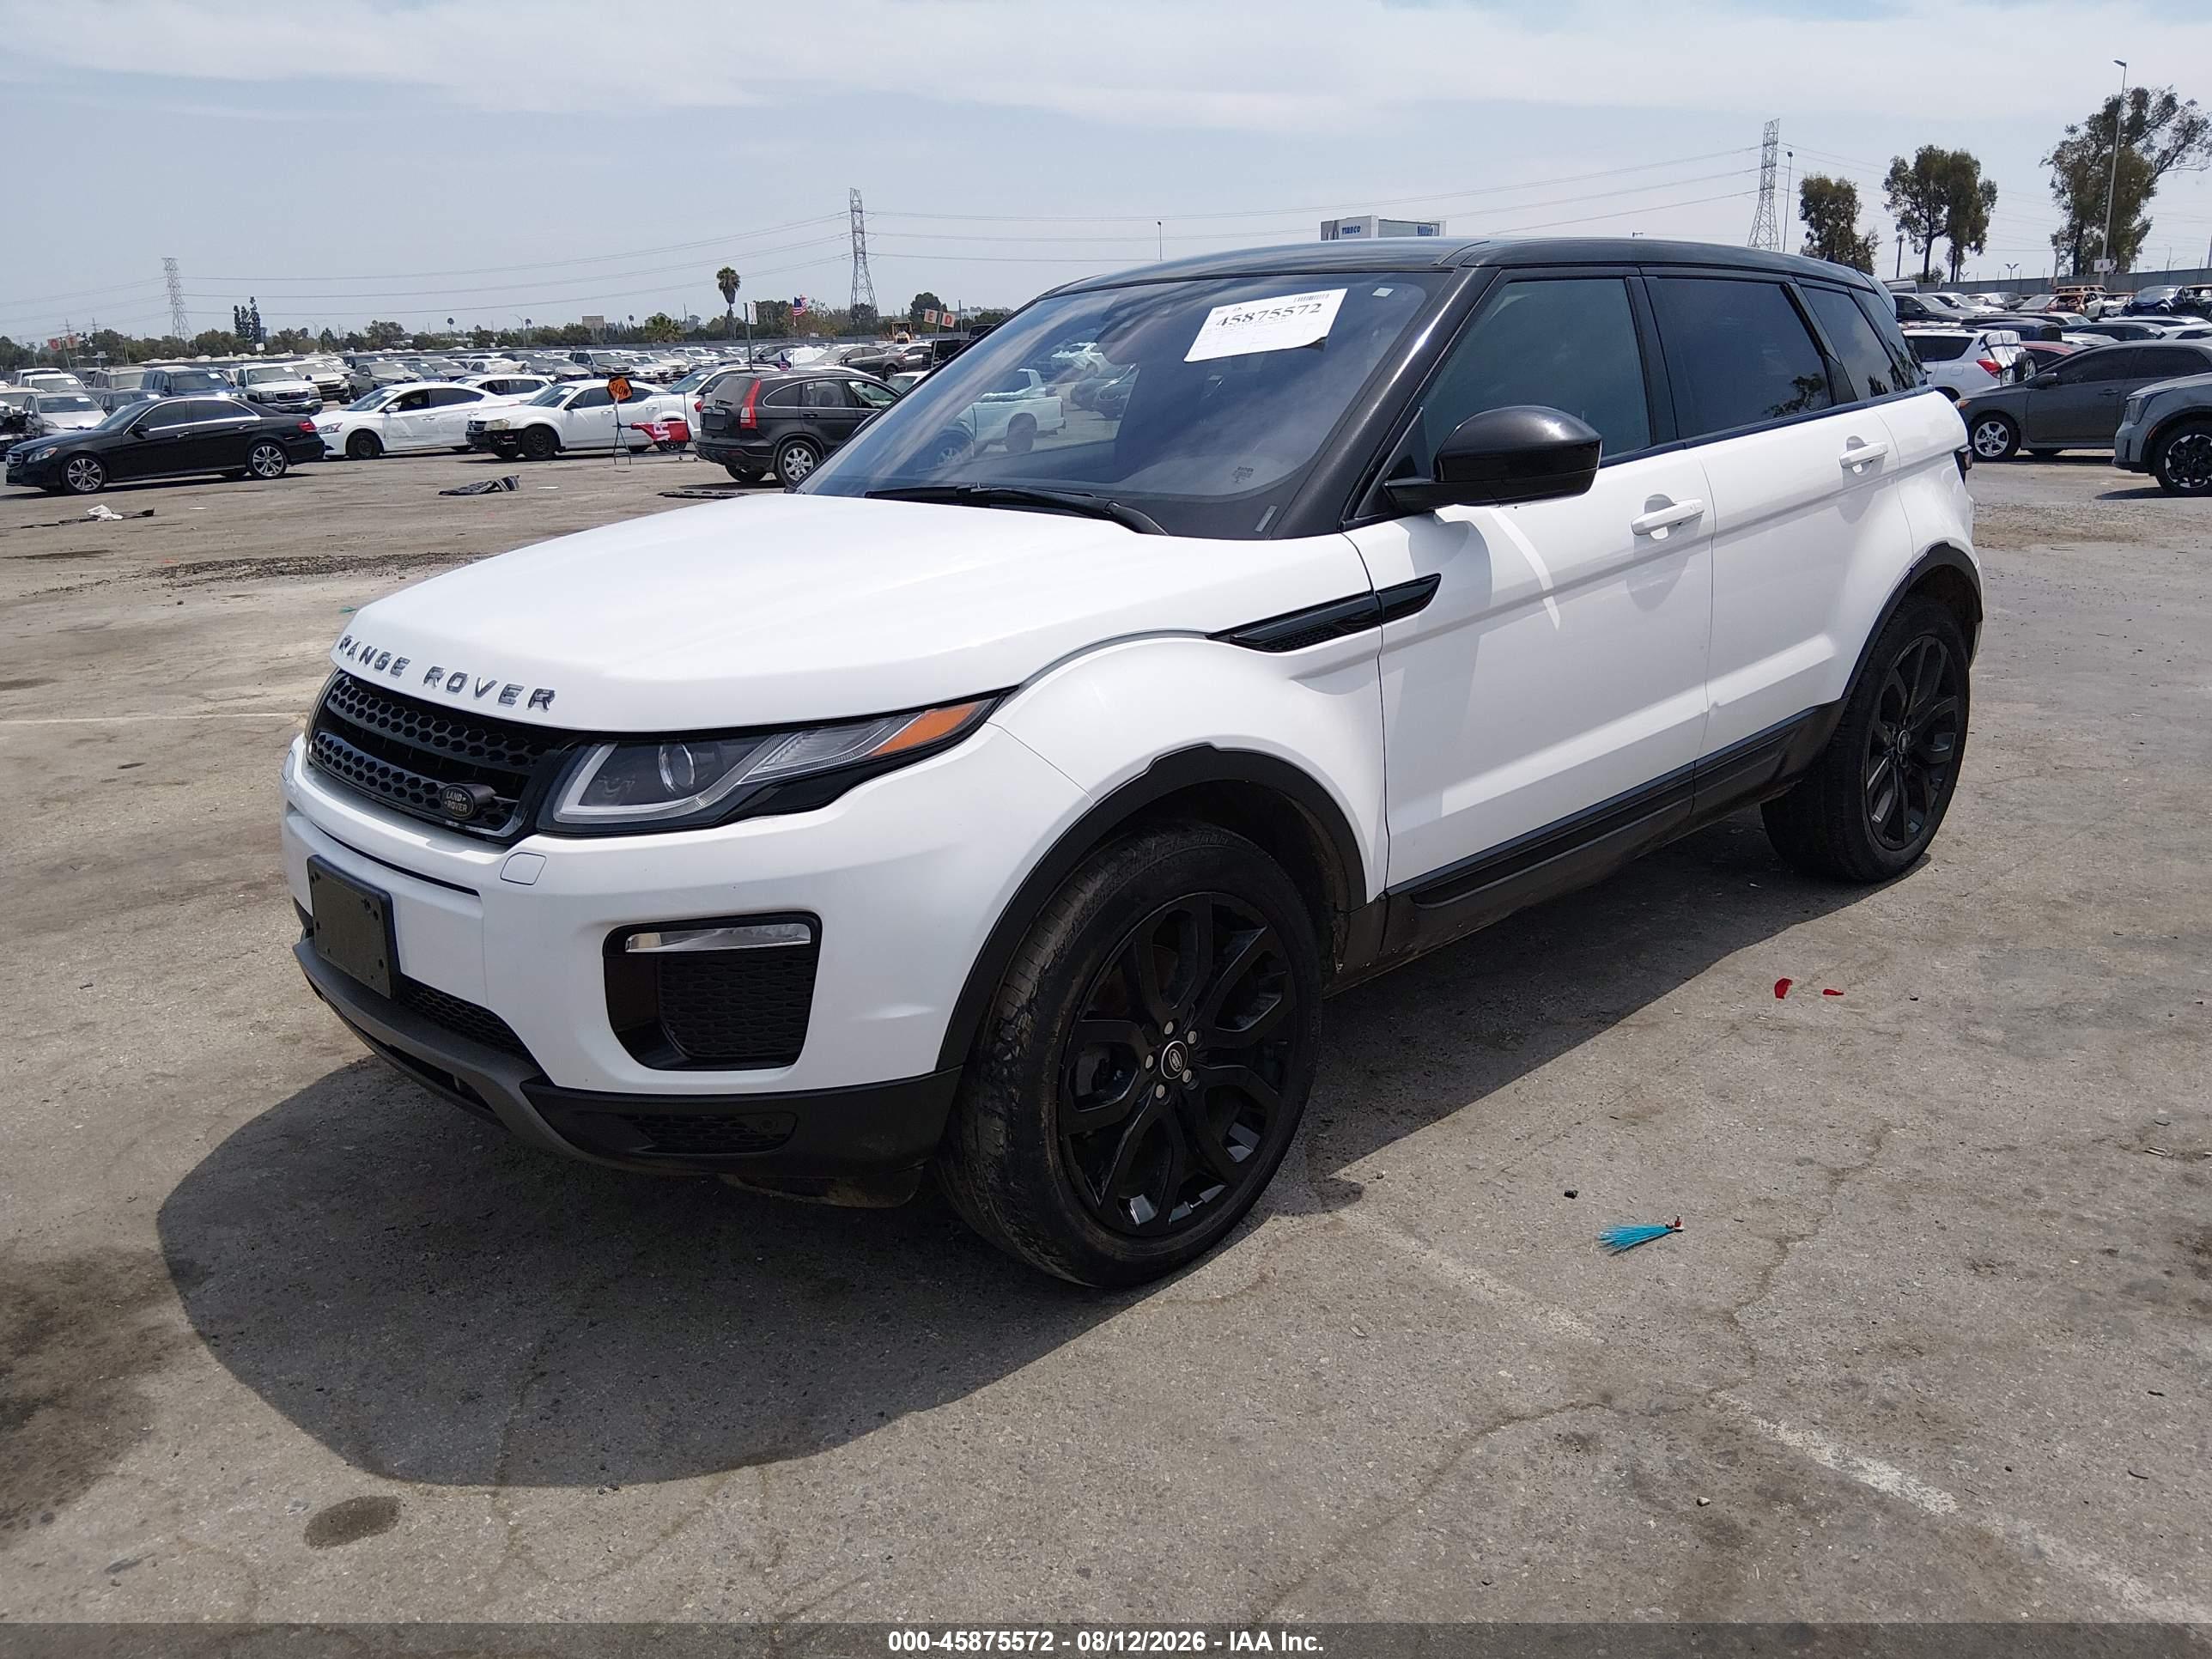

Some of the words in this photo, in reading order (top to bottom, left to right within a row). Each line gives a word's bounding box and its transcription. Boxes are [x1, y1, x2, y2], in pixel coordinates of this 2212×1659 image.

[928, 311, 934, 322] E
[945, 314, 952, 325] D
[1216, 302, 1322, 326] 45875572
[611, 382, 629, 397] SLOW
[337, 634, 410, 678] RANGE
[422, 665, 556, 711] ROVER
[447, 790, 463, 802] LAND
[447, 799, 468, 814] ROVER
